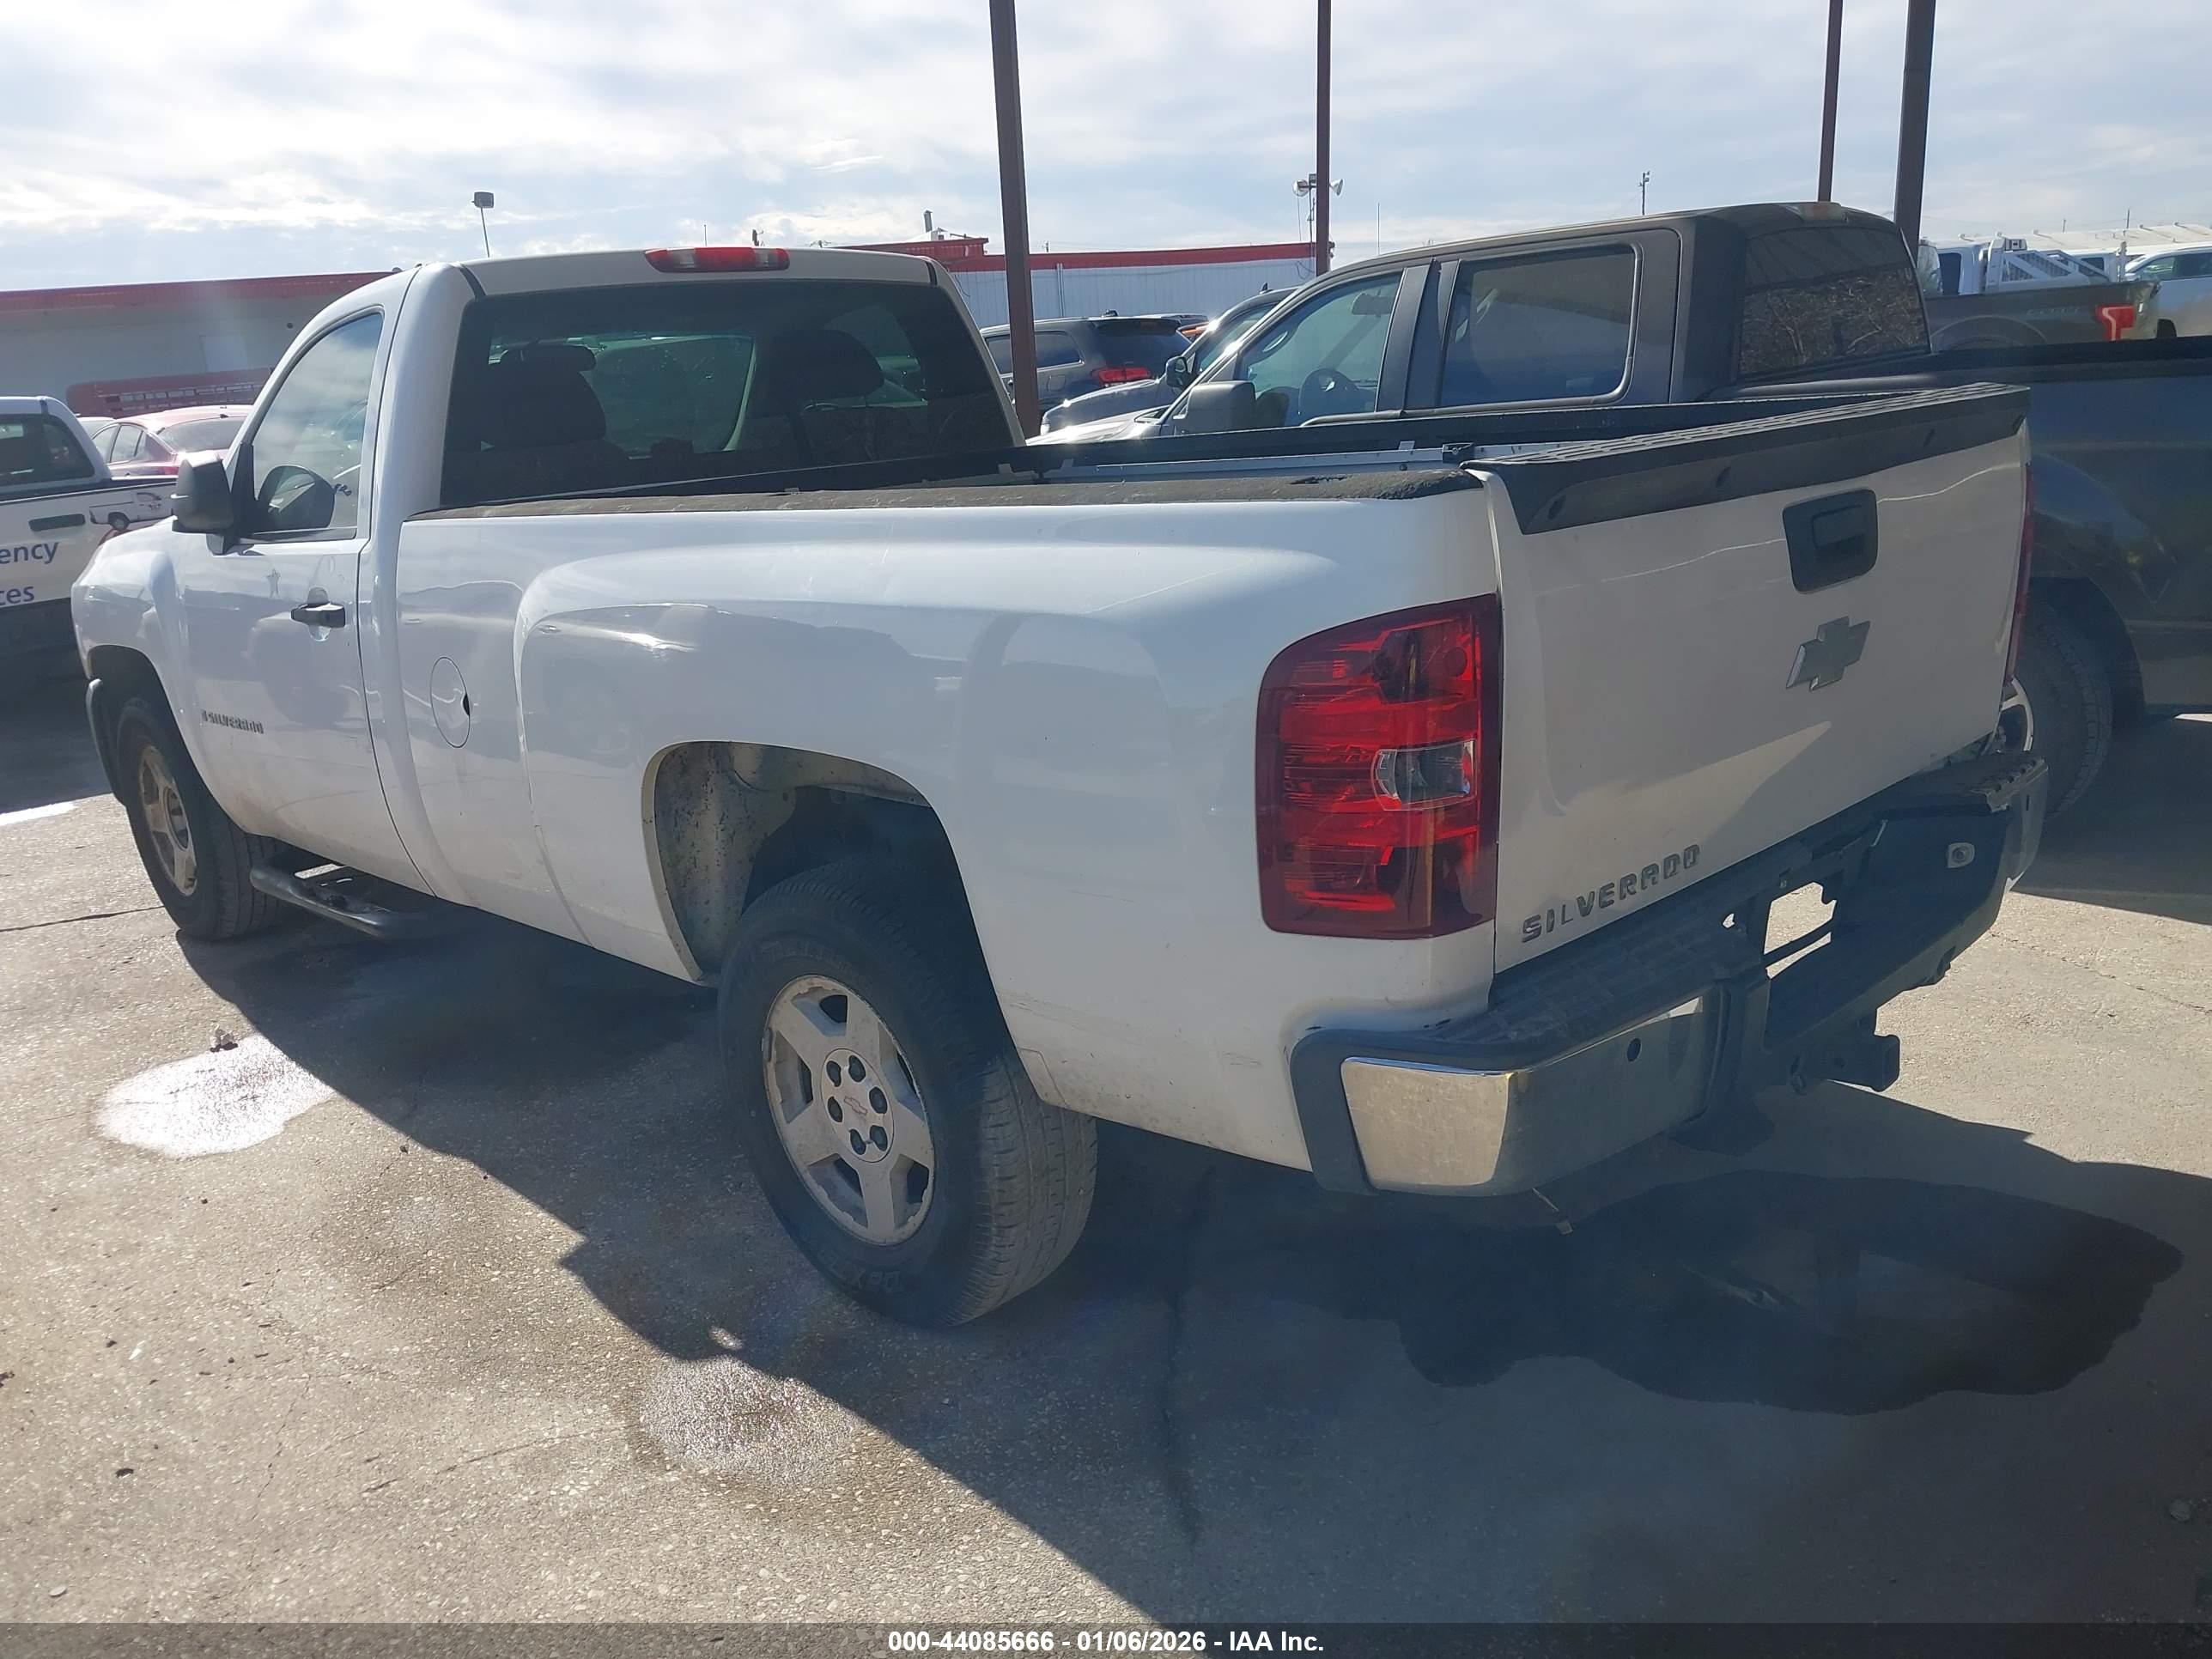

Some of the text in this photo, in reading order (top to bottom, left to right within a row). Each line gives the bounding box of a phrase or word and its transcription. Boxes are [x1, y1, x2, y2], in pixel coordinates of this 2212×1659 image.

[0, 542, 59, 564] ency
[207, 712, 264, 734] SILVERADO
[1522, 844, 1700, 943] SILVERADO
